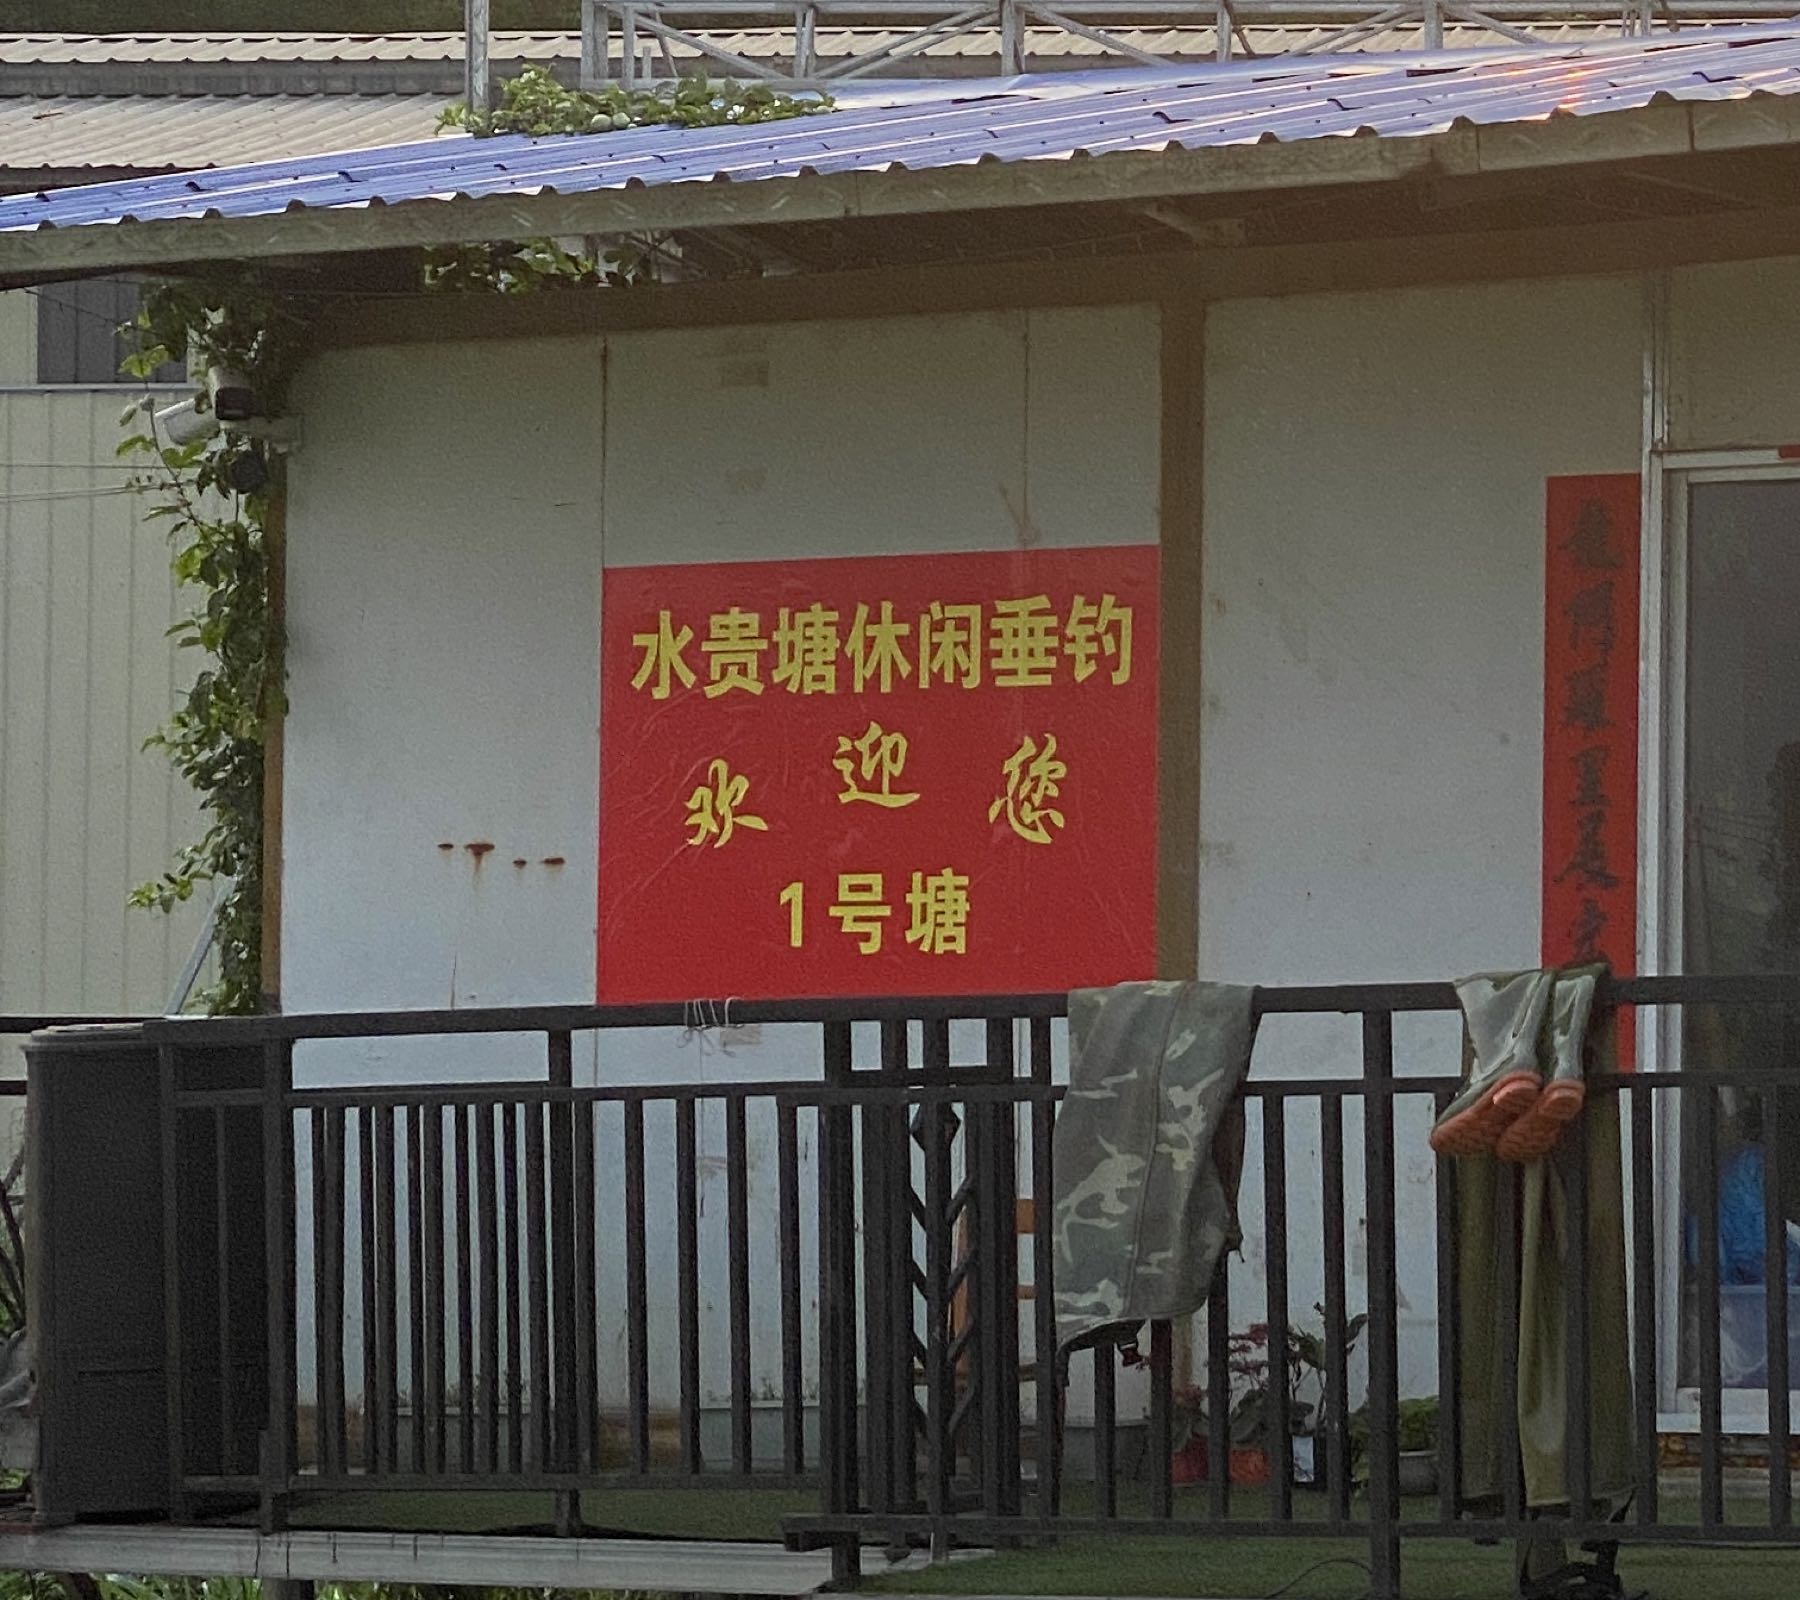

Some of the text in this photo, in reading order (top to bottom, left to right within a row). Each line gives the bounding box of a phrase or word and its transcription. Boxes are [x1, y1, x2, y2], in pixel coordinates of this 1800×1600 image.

[631, 594, 1133, 700] 水贵塘休闲垂钓
[684, 721, 1067, 848] 欢迎您
[780, 867, 970, 954] 1号塘
